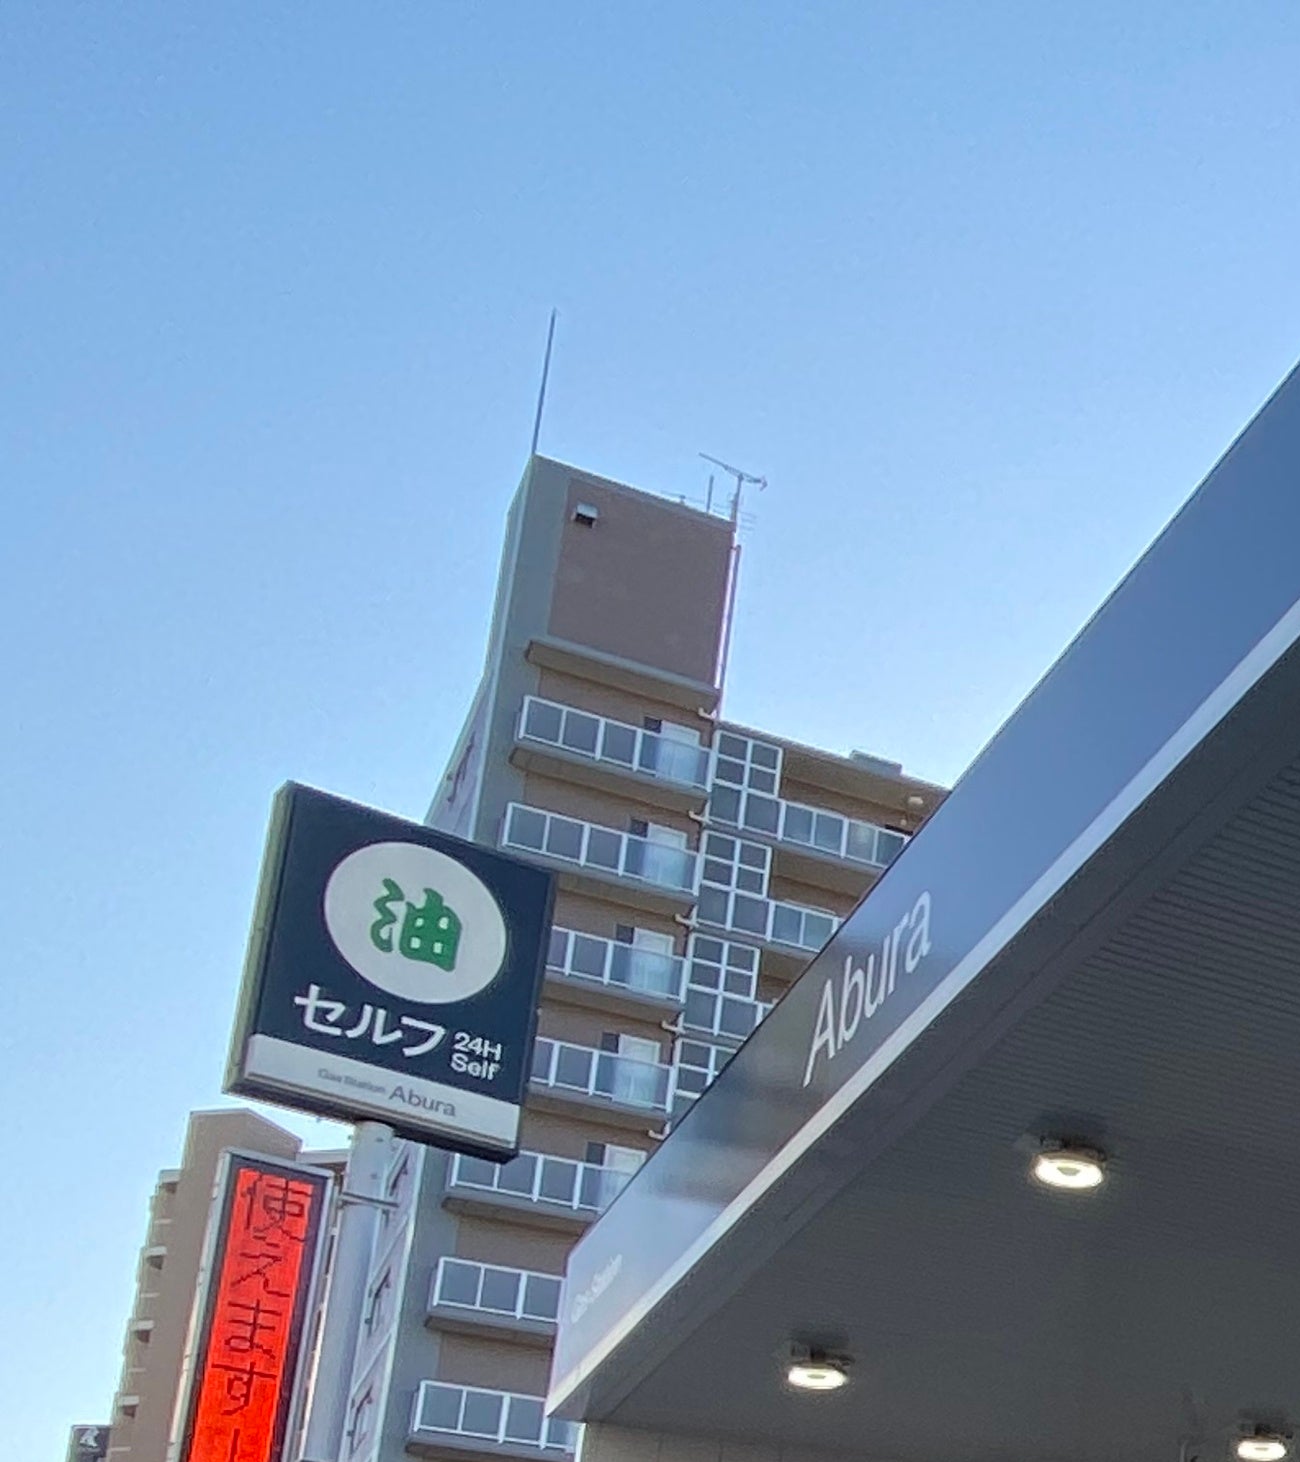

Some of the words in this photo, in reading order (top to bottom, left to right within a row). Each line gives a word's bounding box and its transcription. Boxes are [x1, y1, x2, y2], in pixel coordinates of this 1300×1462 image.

[371, 878, 462, 972] 油
[803, 891, 931, 1087] Abura
[294, 984, 446, 1057] セルフ
[453, 1032, 501, 1061] 24H
[450, 1053, 500, 1080] Self
[389, 1085, 456, 1117] Abura
